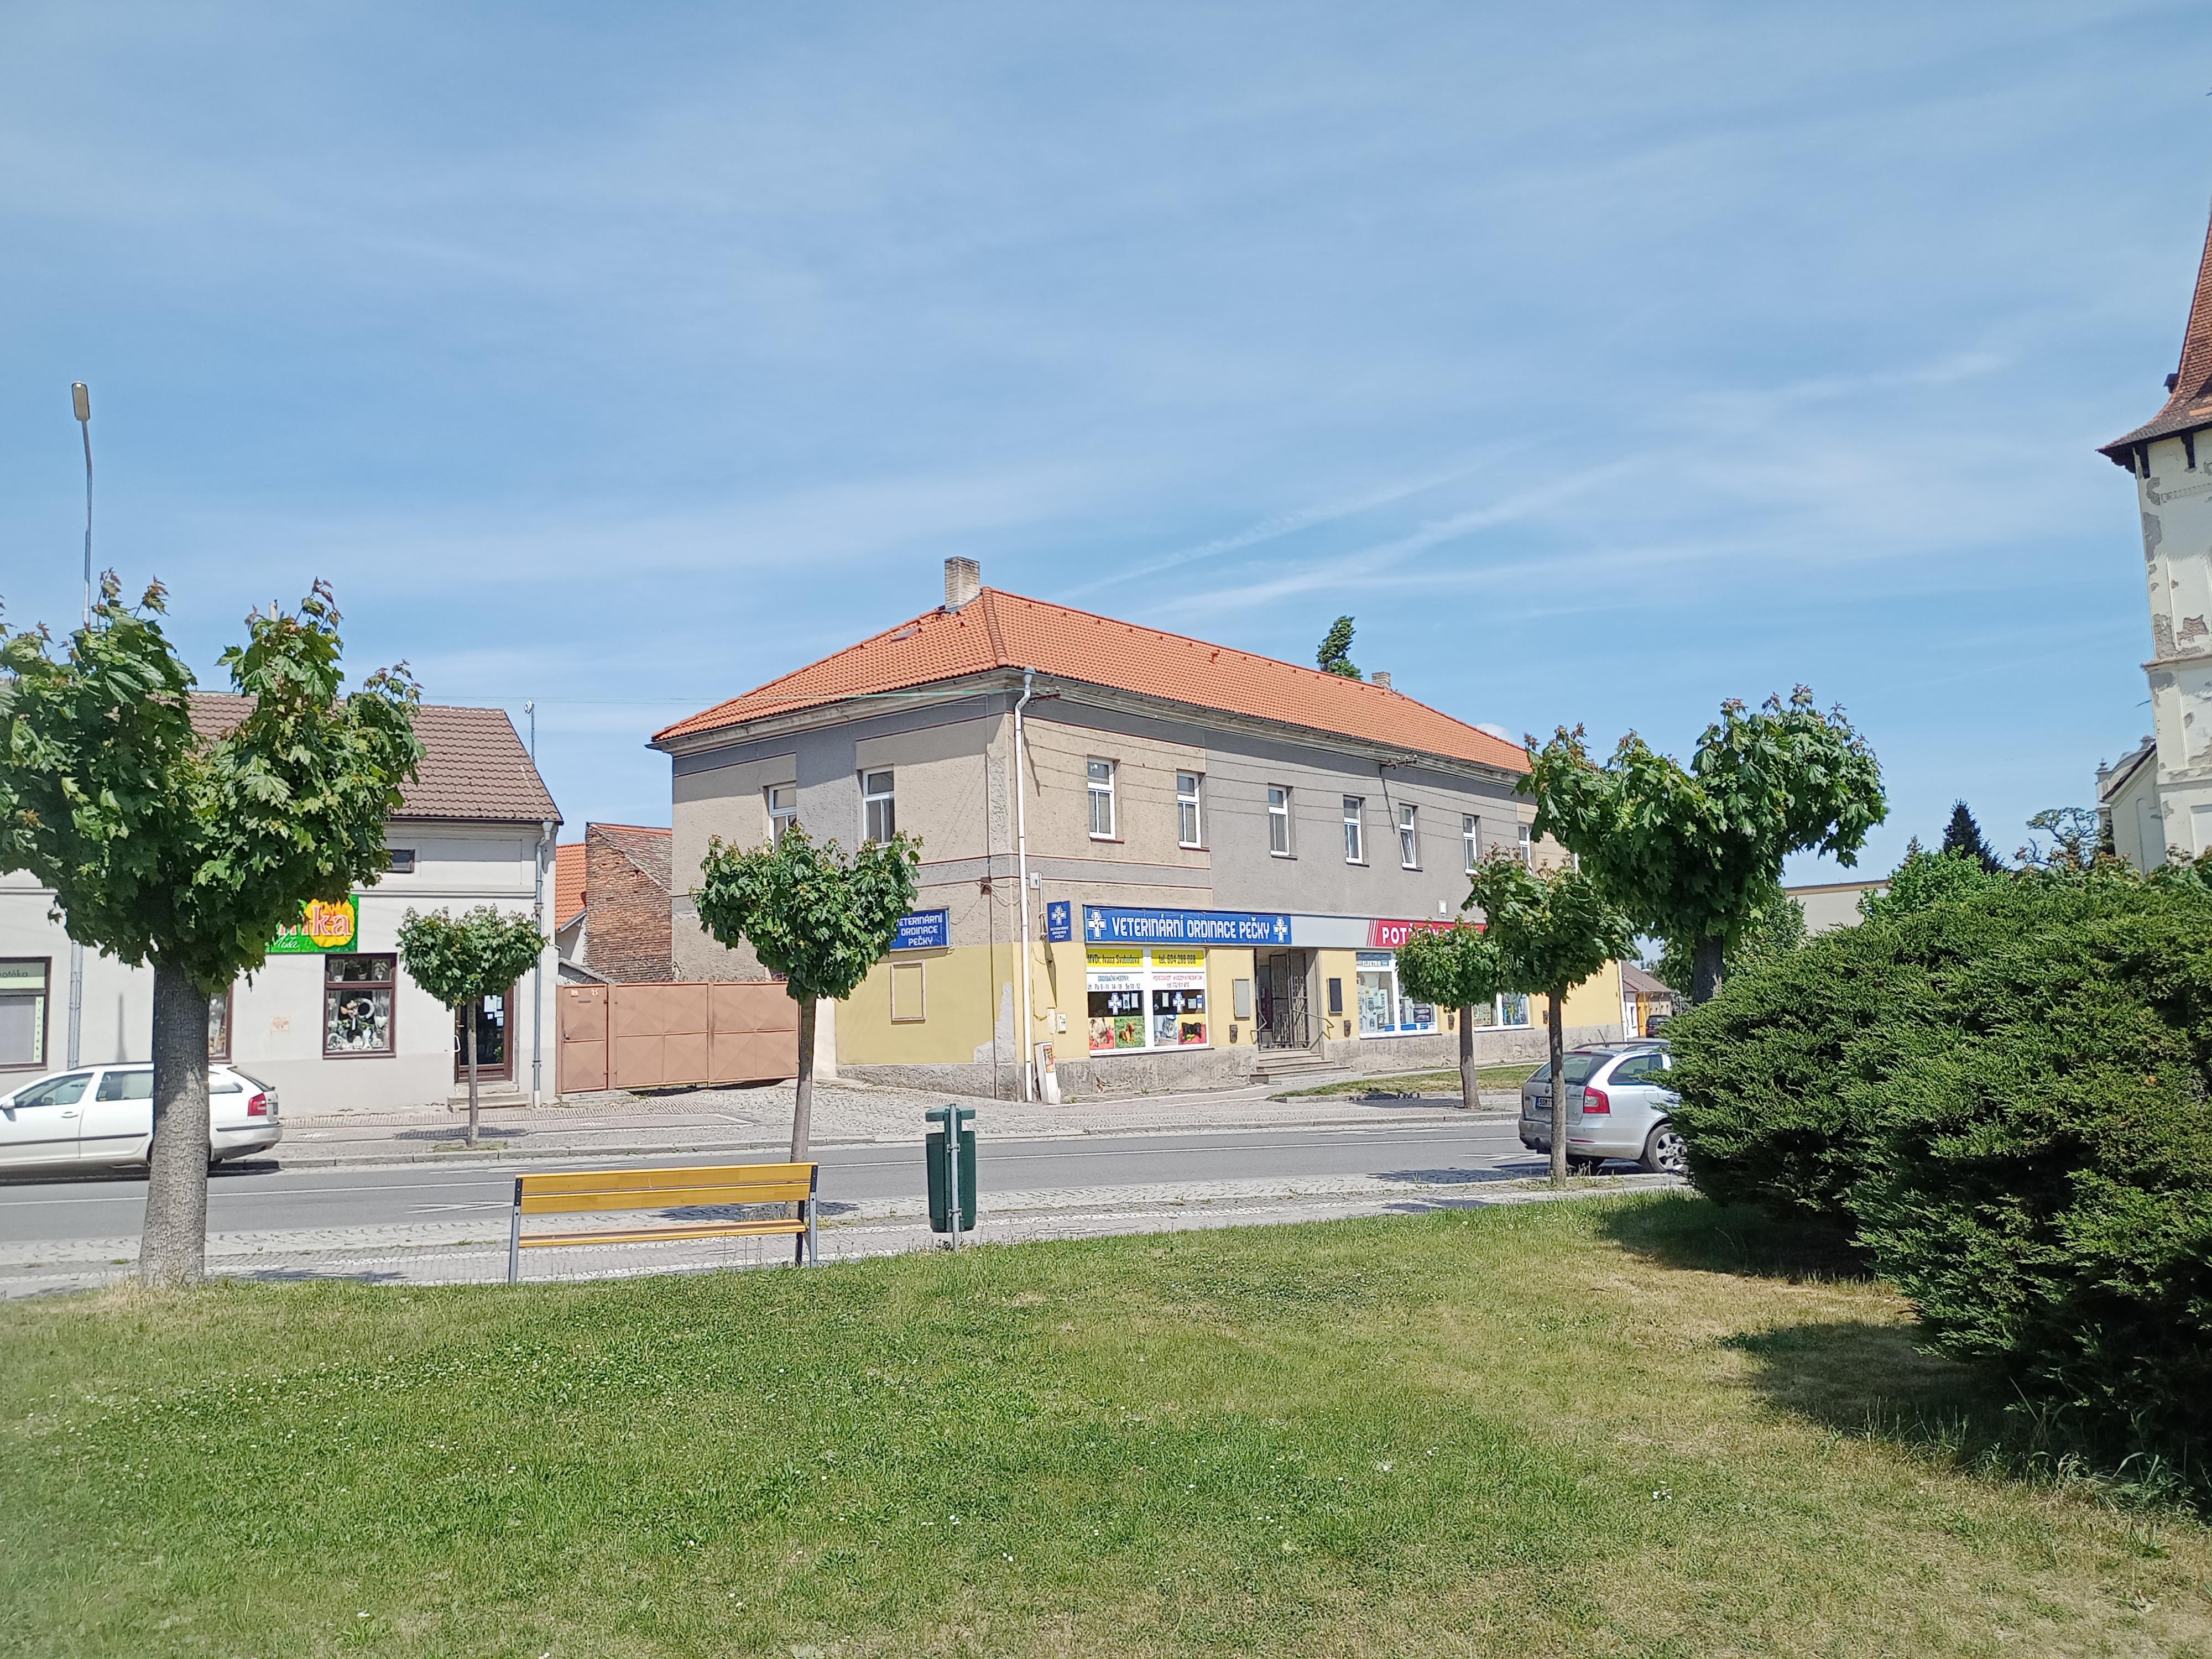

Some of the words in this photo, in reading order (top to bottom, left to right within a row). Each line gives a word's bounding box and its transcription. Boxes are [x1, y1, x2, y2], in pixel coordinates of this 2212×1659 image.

[901, 925, 938, 936] ORDINACE
[1112, 914, 1184, 938] VETERINÁRNÍ
[1187, 919, 1237, 939] ORDINACE
[1239, 917, 1270, 940] PEČKY
[908, 935, 933, 947] PEČKY
[1087, 954, 1102, 964] MVDr.
[1102, 954, 1115, 964] Ivana
